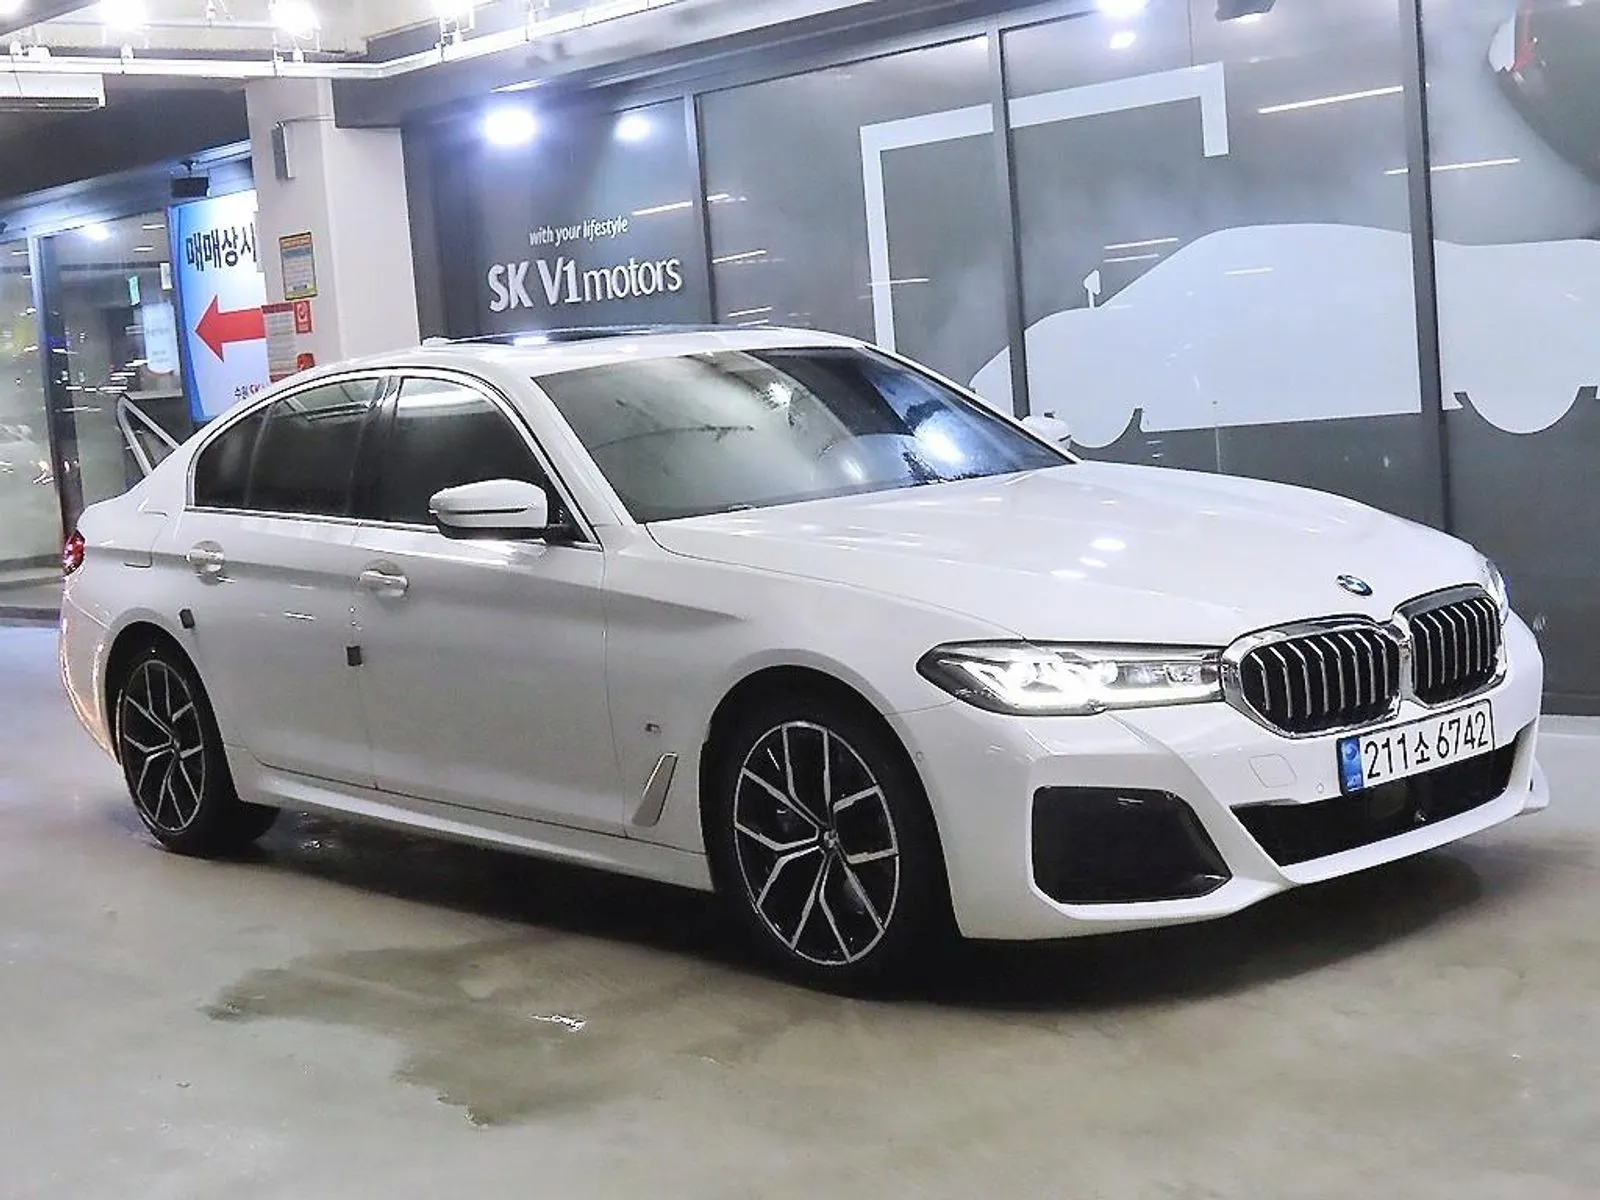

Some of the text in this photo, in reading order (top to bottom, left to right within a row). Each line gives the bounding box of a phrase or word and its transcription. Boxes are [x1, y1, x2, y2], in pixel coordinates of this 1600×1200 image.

[529, 214, 628, 247] with your lifestyle
[487, 261, 534, 312] SK
